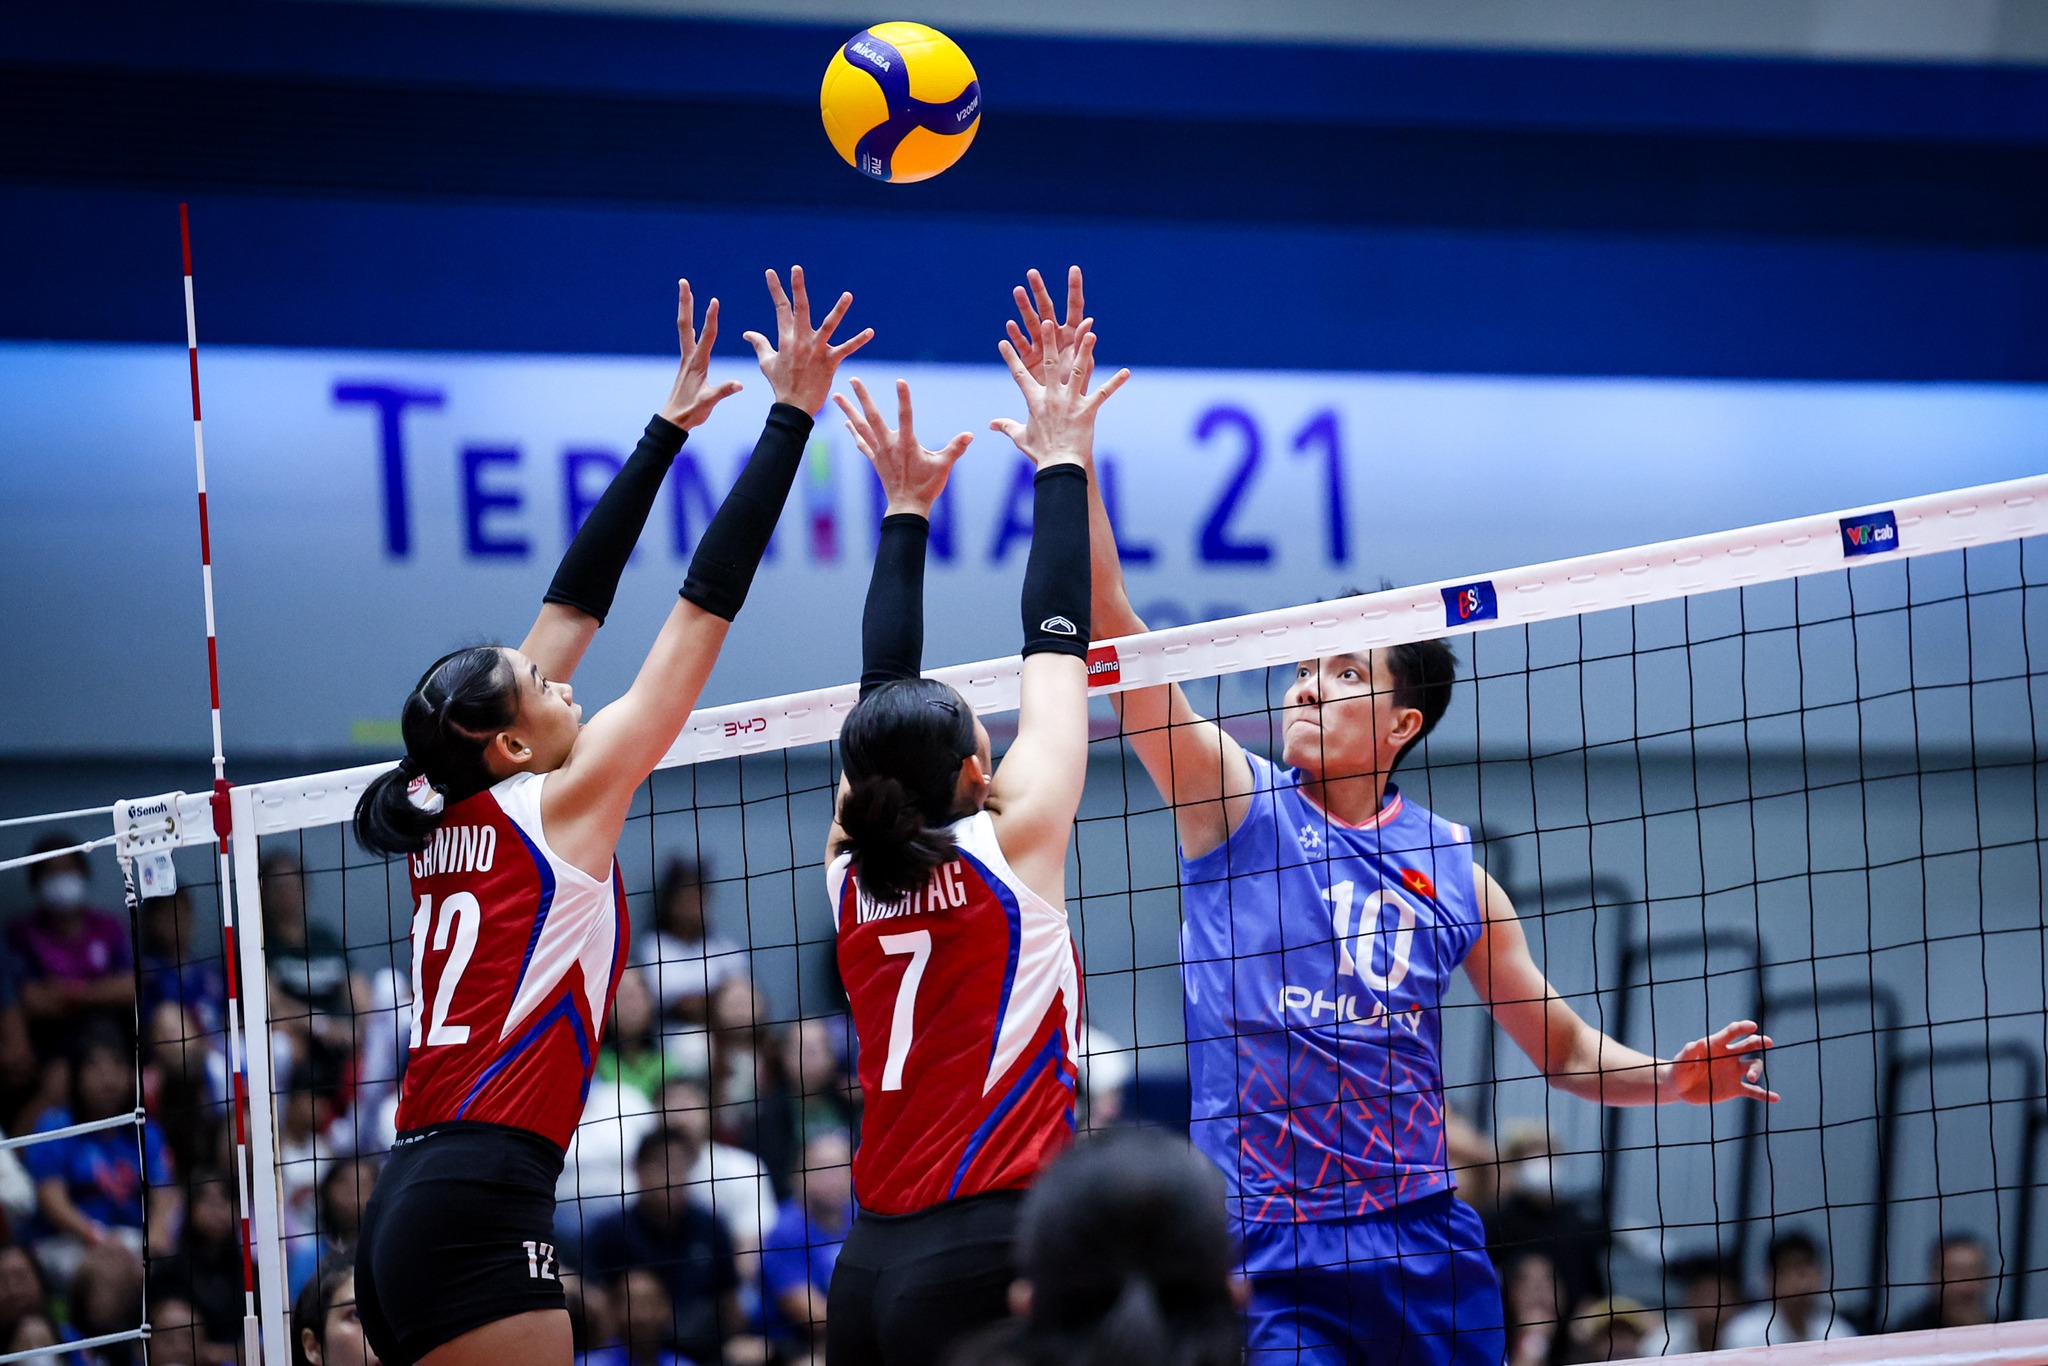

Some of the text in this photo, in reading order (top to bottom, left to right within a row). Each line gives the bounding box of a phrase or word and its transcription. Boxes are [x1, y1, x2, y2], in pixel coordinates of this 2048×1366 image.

[1195, 405, 1346, 563] 21
[724, 717, 767, 737] BYD
[137, 802, 168, 817] Senoh
[409, 891, 481, 1048] 12
[1322, 880, 1415, 992] 10
[878, 929, 932, 1092] 7
[522, 1240, 556, 1280] 12
